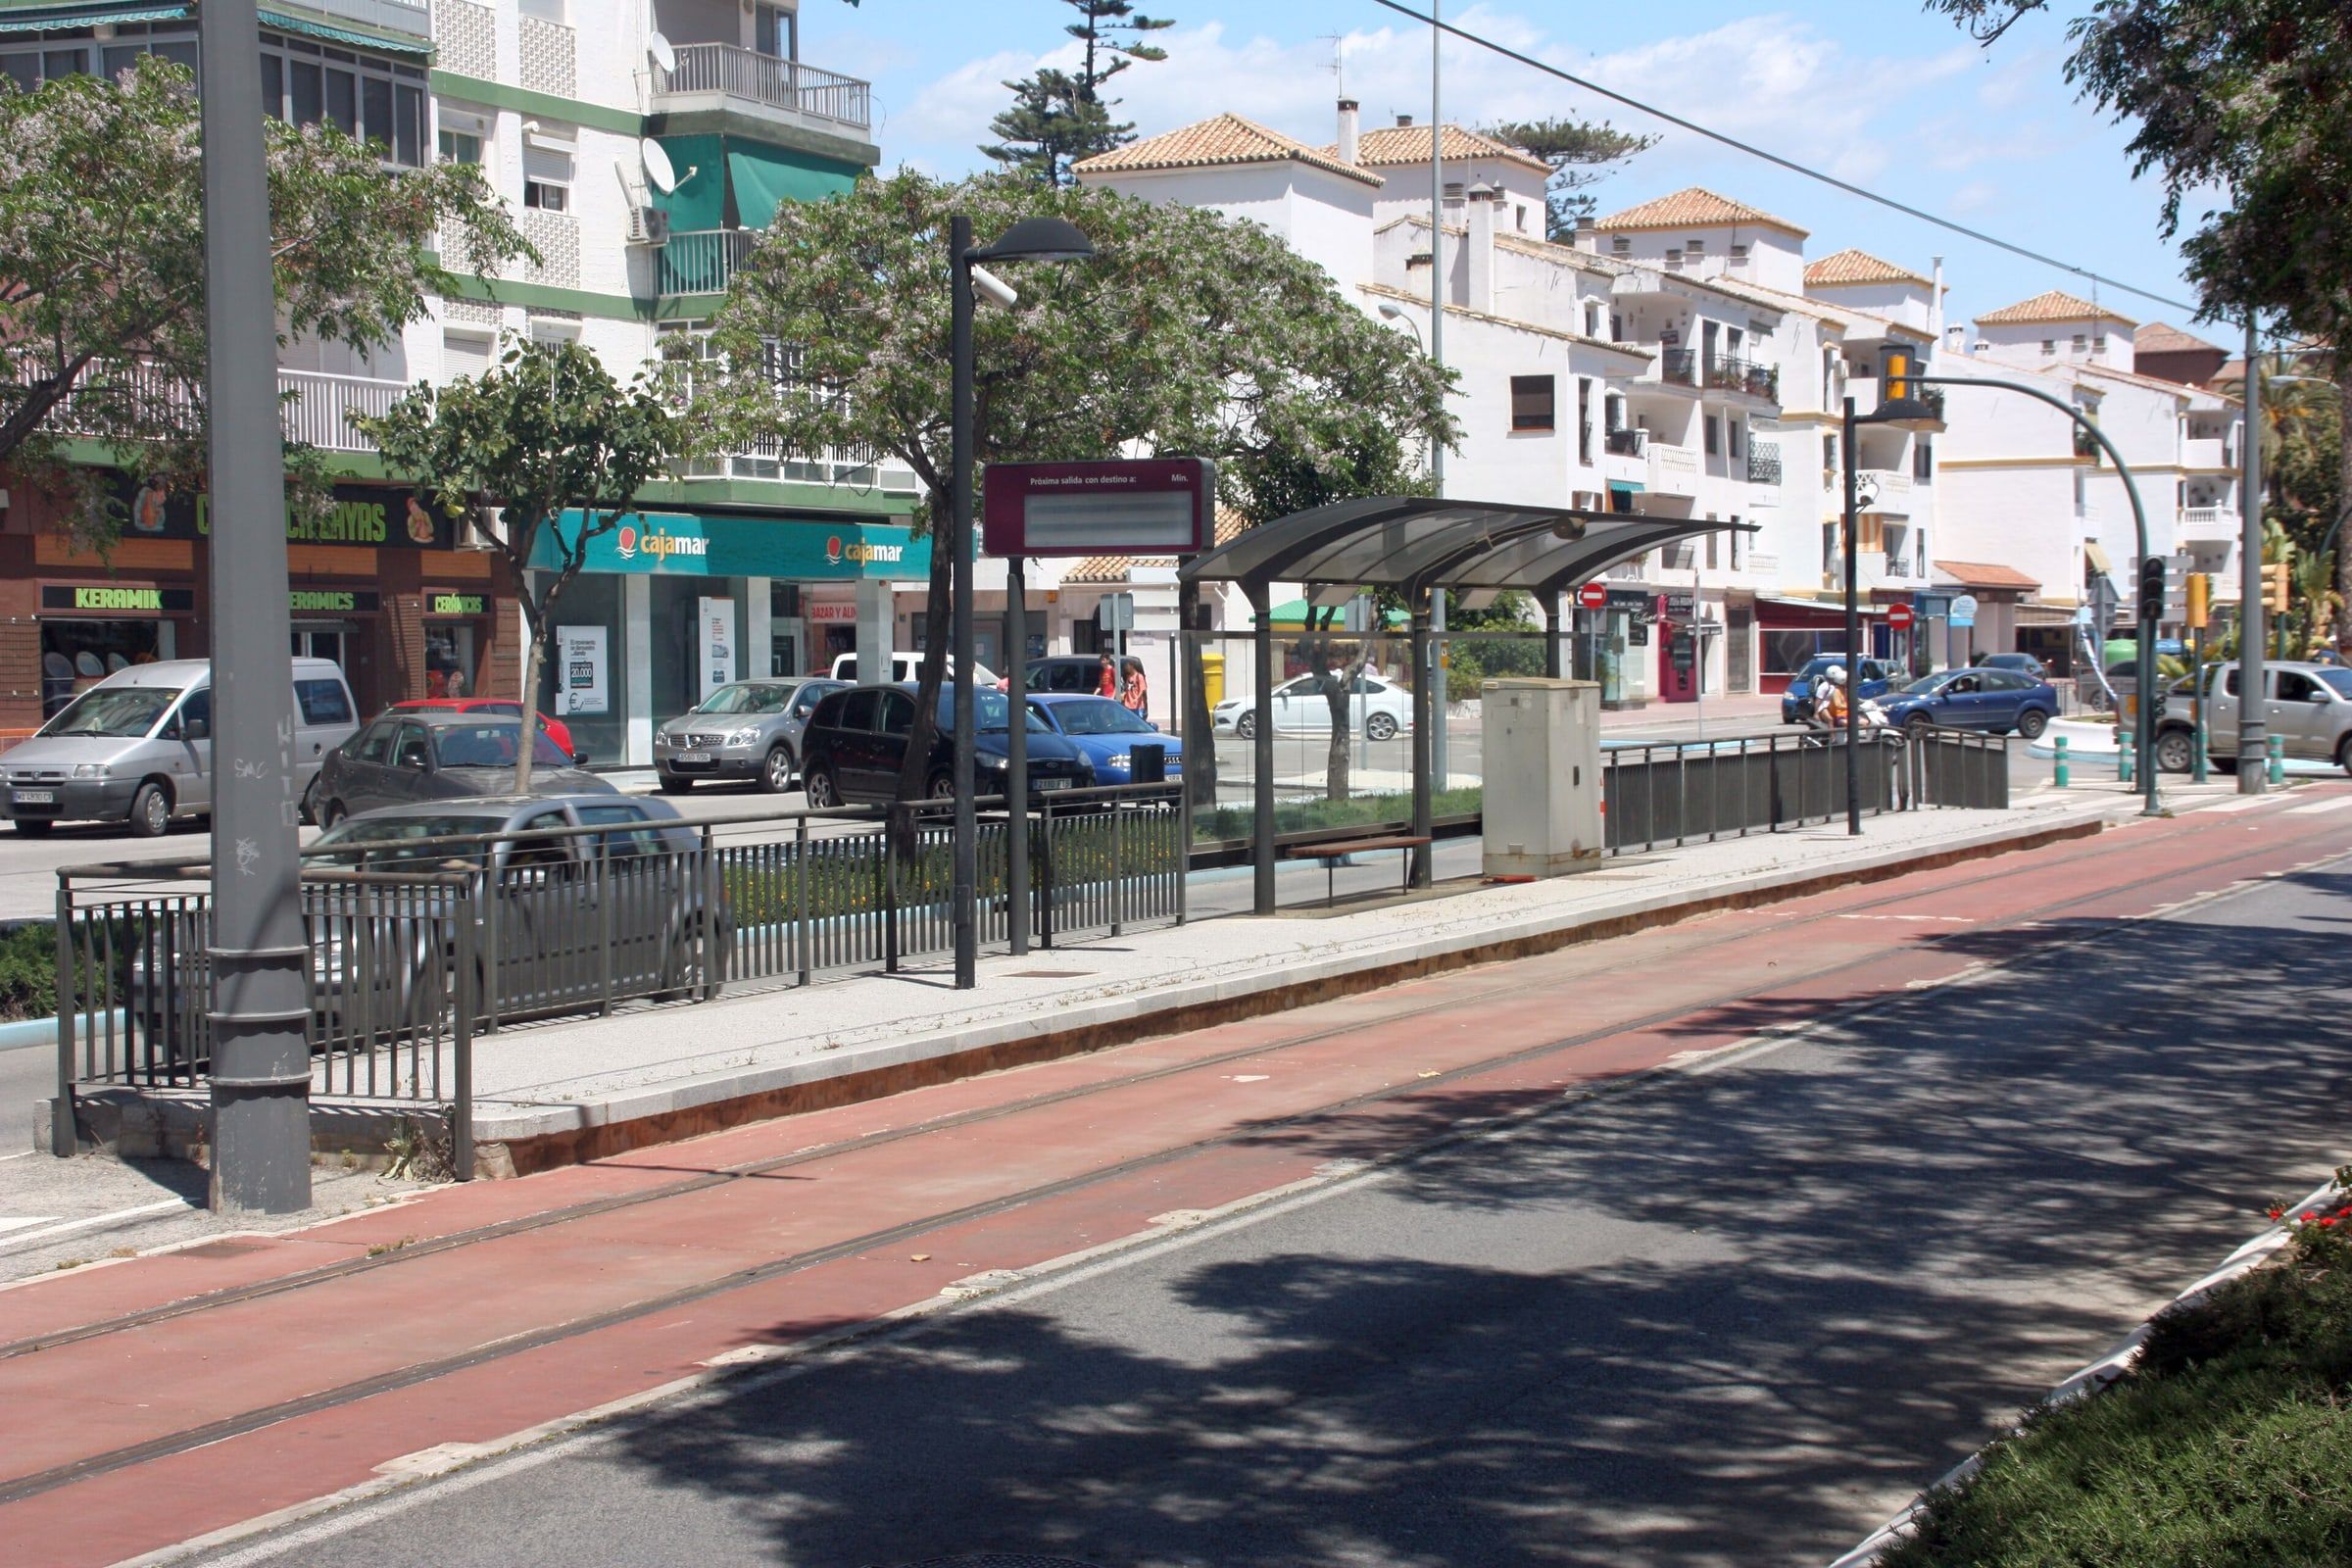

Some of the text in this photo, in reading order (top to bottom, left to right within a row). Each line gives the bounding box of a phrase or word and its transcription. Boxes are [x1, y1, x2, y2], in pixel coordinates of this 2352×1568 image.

[1060, 476, 1082, 485] salida
[1100, 475, 1127, 484] destino
[1171, 473, 1188, 482] Min.
[640, 528, 710, 562] cajamar
[845, 537, 903, 566] cajamar
[75, 588, 163, 609] KERAMIK
[289, 591, 354, 611] ERAMICS
[835, 607, 841, 618] Y
